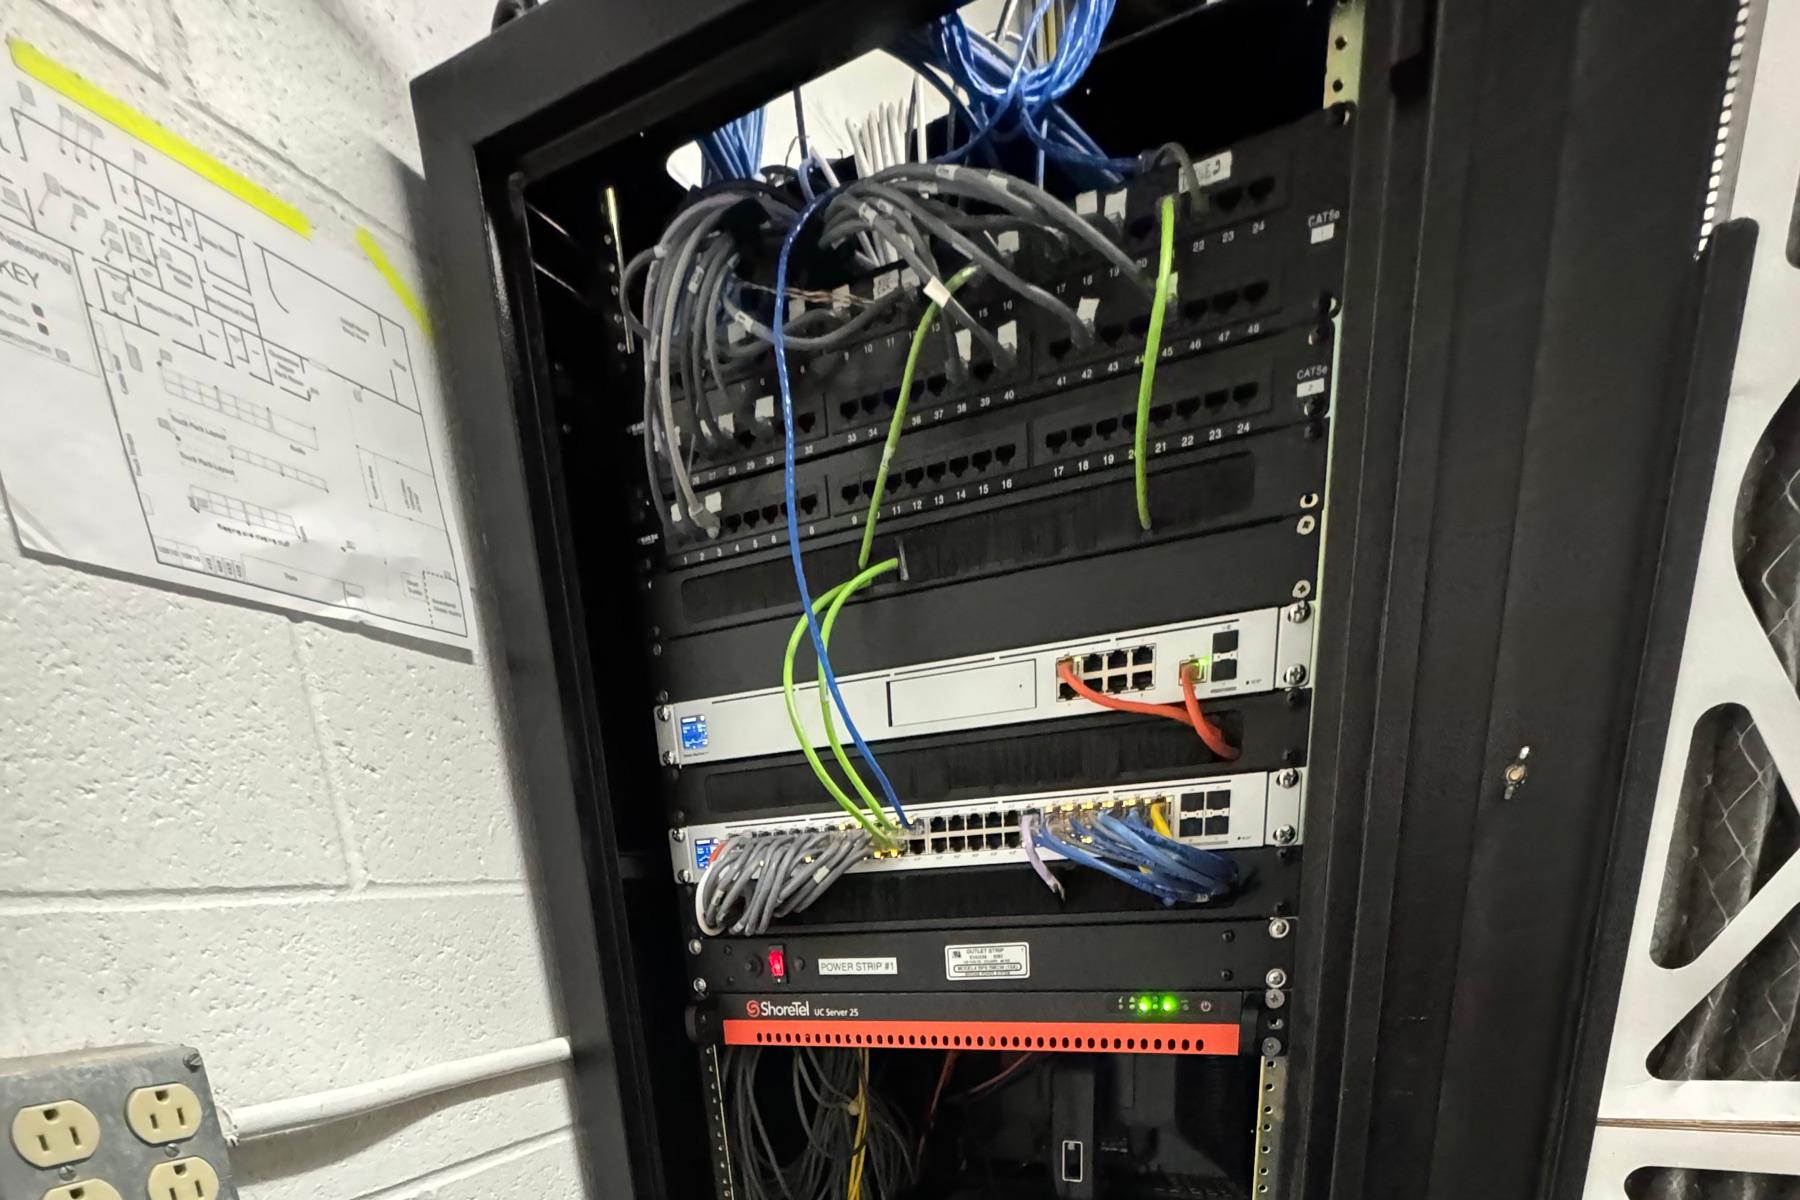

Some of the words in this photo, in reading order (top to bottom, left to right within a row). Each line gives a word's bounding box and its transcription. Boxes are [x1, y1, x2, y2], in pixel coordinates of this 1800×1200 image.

[1308, 209, 1340, 227] CAT5e
[1057, 376, 1066, 386] 41
[1082, 369, 1092, 379] 42
[1108, 362, 1118, 371] 43
[1162, 347, 1173, 357] 45
[1219, 331, 1230, 342] 47
[1297, 365, 1327, 379] CAT5e
[869, 428, 877, 437] 34
[934, 410, 943, 420] 37
[980, 397, 990, 407] 39
[1004, 390, 1014, 400] 40
[747, 461, 755, 470] 29
[766, 456, 774, 465] 30
[805, 445, 813, 454] 32
[1054, 466, 1064, 477] 17
[1078, 460, 1089, 471] 18
[1104, 454, 1114, 465] 19
[1155, 442, 1166, 453] 21
[1182, 435, 1194, 447] 22
[1209, 429, 1222, 440] 23
[1237, 422, 1250, 434] 24
[892, 506, 901, 515] 11
[913, 500, 922, 510] 12
[935, 495, 944, 505] 13
[957, 490, 966, 499] 14
[979, 484, 989, 494] 15
[1002, 479, 1012, 489] 16
[821, 962, 853, 971] POWER
[856, 962, 882, 971] STRIP
[885, 962, 893, 970] #1
[761, 1001, 810, 1016] ShoreTel
[814, 1008, 824, 1016] UC
[826, 1008, 847, 1016] Server
[849, 1008, 858, 1016] 25
